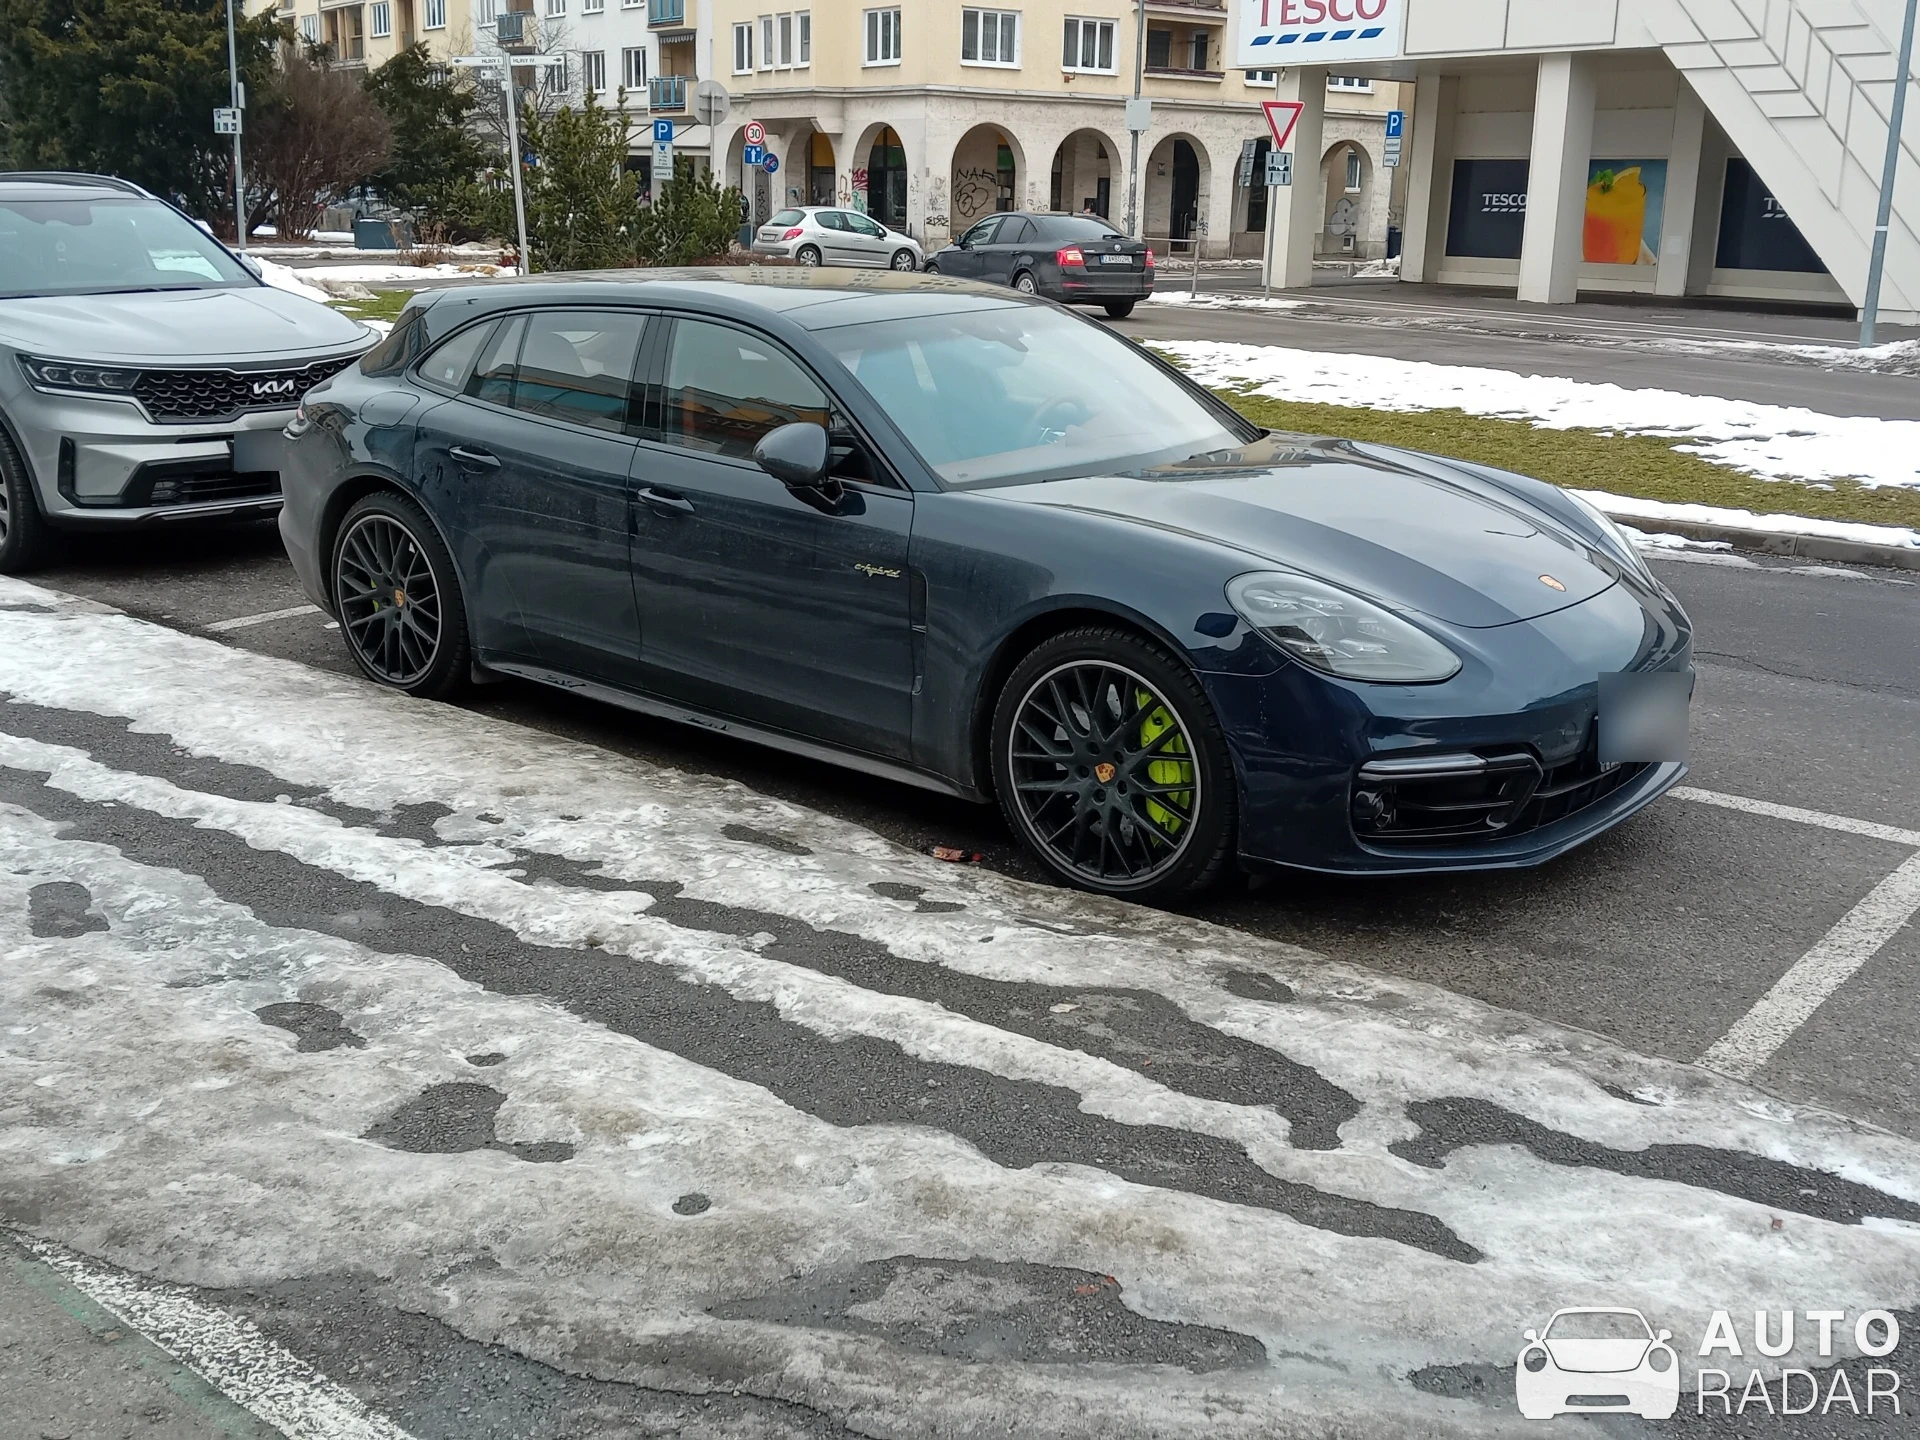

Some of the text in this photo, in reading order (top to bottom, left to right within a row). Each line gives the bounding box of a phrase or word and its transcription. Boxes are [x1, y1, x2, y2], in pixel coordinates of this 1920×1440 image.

[658, 122, 669, 139] P
[1389, 114, 1400, 134] P
[749, 128, 761, 139] 30
[1482, 193, 1527, 206] TESCO
[253, 380, 294, 394] KIA
